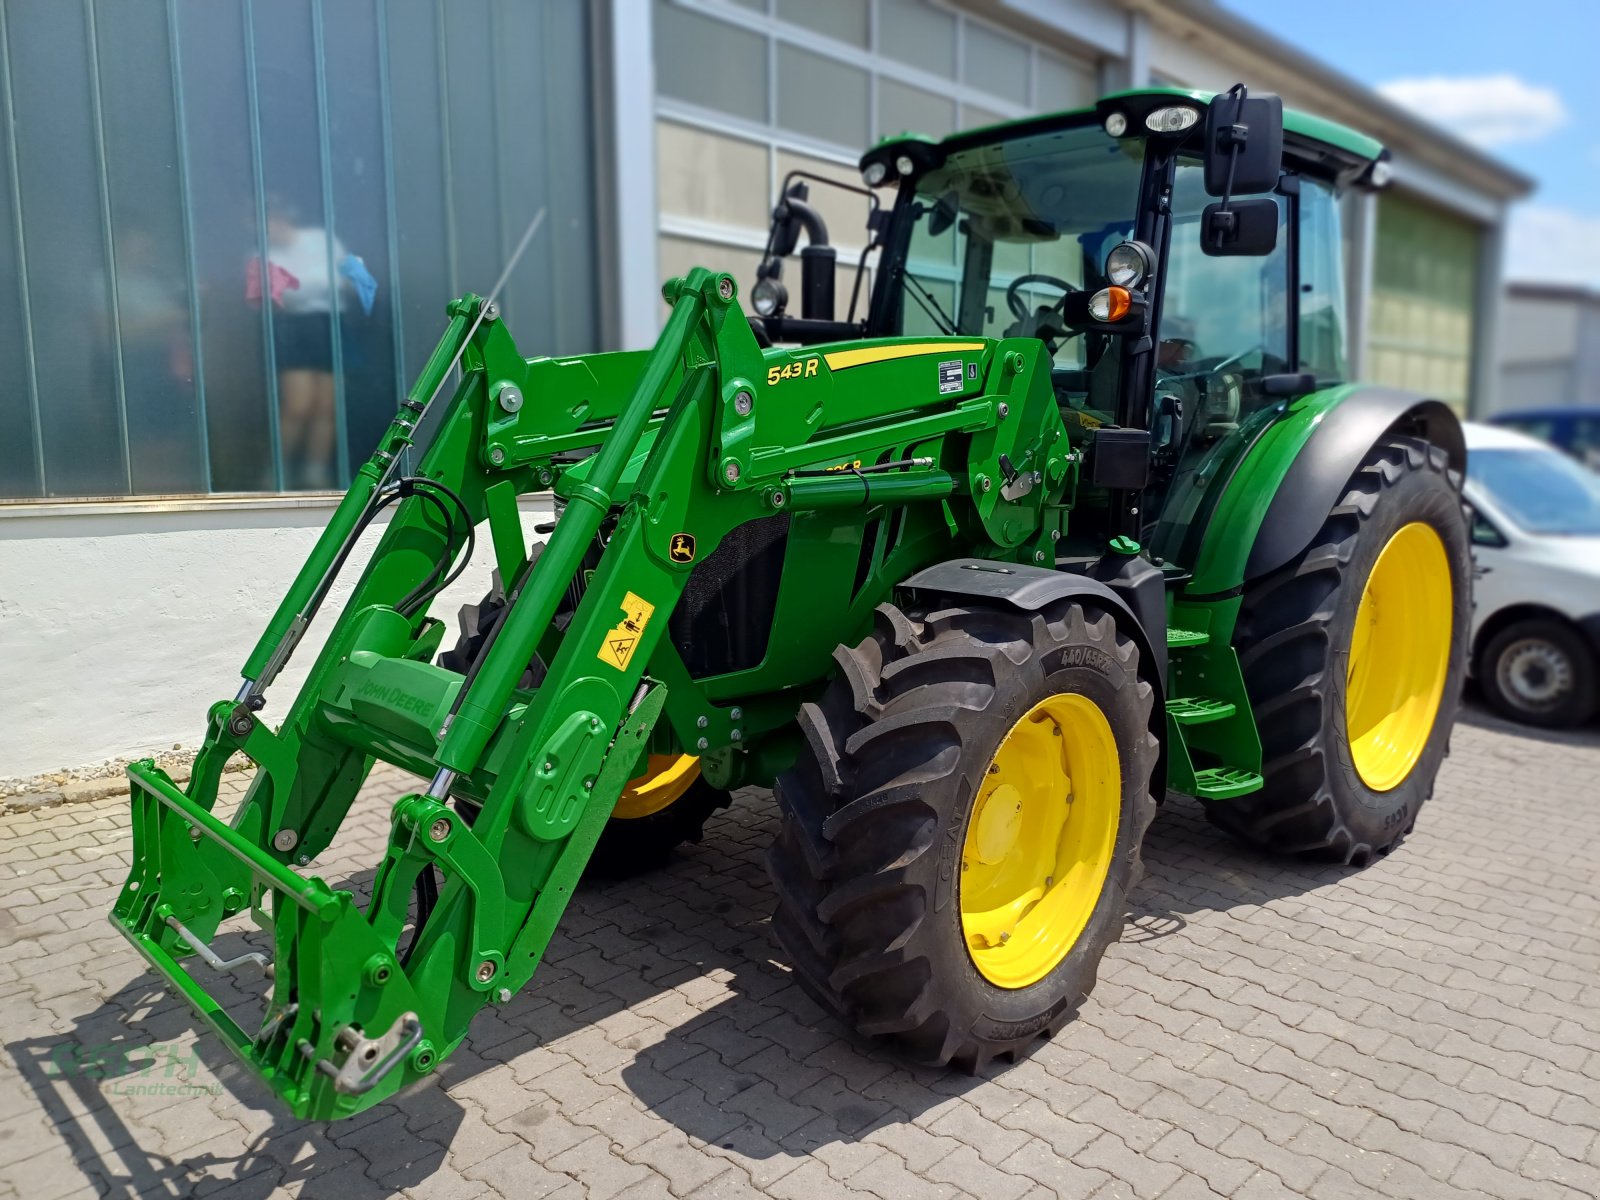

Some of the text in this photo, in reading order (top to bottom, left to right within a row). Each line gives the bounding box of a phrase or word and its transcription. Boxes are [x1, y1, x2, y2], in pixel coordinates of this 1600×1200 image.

[767, 358, 819, 386] 543 R
[358, 679, 435, 717] JOHN DEERE
